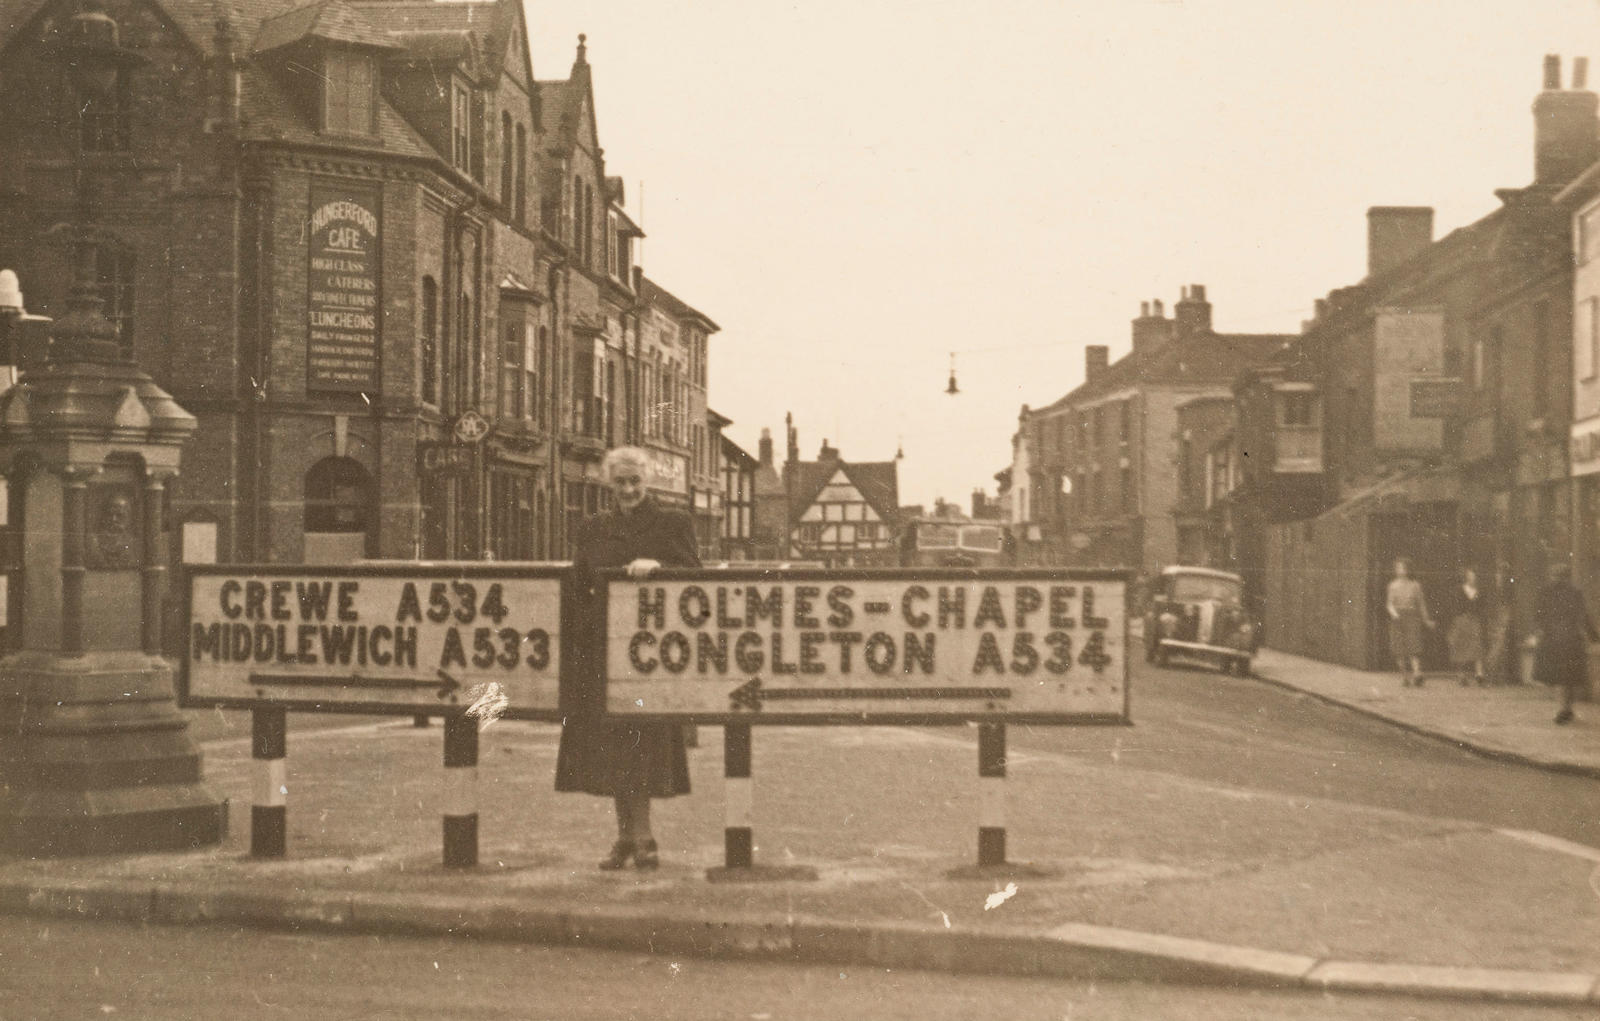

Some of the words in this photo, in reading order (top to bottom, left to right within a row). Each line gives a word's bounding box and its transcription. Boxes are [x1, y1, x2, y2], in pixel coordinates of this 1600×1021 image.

[312, 201, 377, 237] HUNGERFORD
[329, 227, 360, 248] CAFE
[312, 258, 333, 270] HIGH
[334, 260, 365, 271] CLASS
[327, 275, 376, 290] CATERERS
[311, 312, 375, 329] LUNCHEONS
[220, 580, 360, 622] CREWE
[397, 581, 508, 625] A534
[637, 586, 1109, 630] HOLMES-CHAPEL
[192, 622, 417, 668] MIDDLEWICH
[441, 627, 551, 671] A533
[628, 630, 936, 675] CONGLETON
[971, 631, 1111, 675] A534
